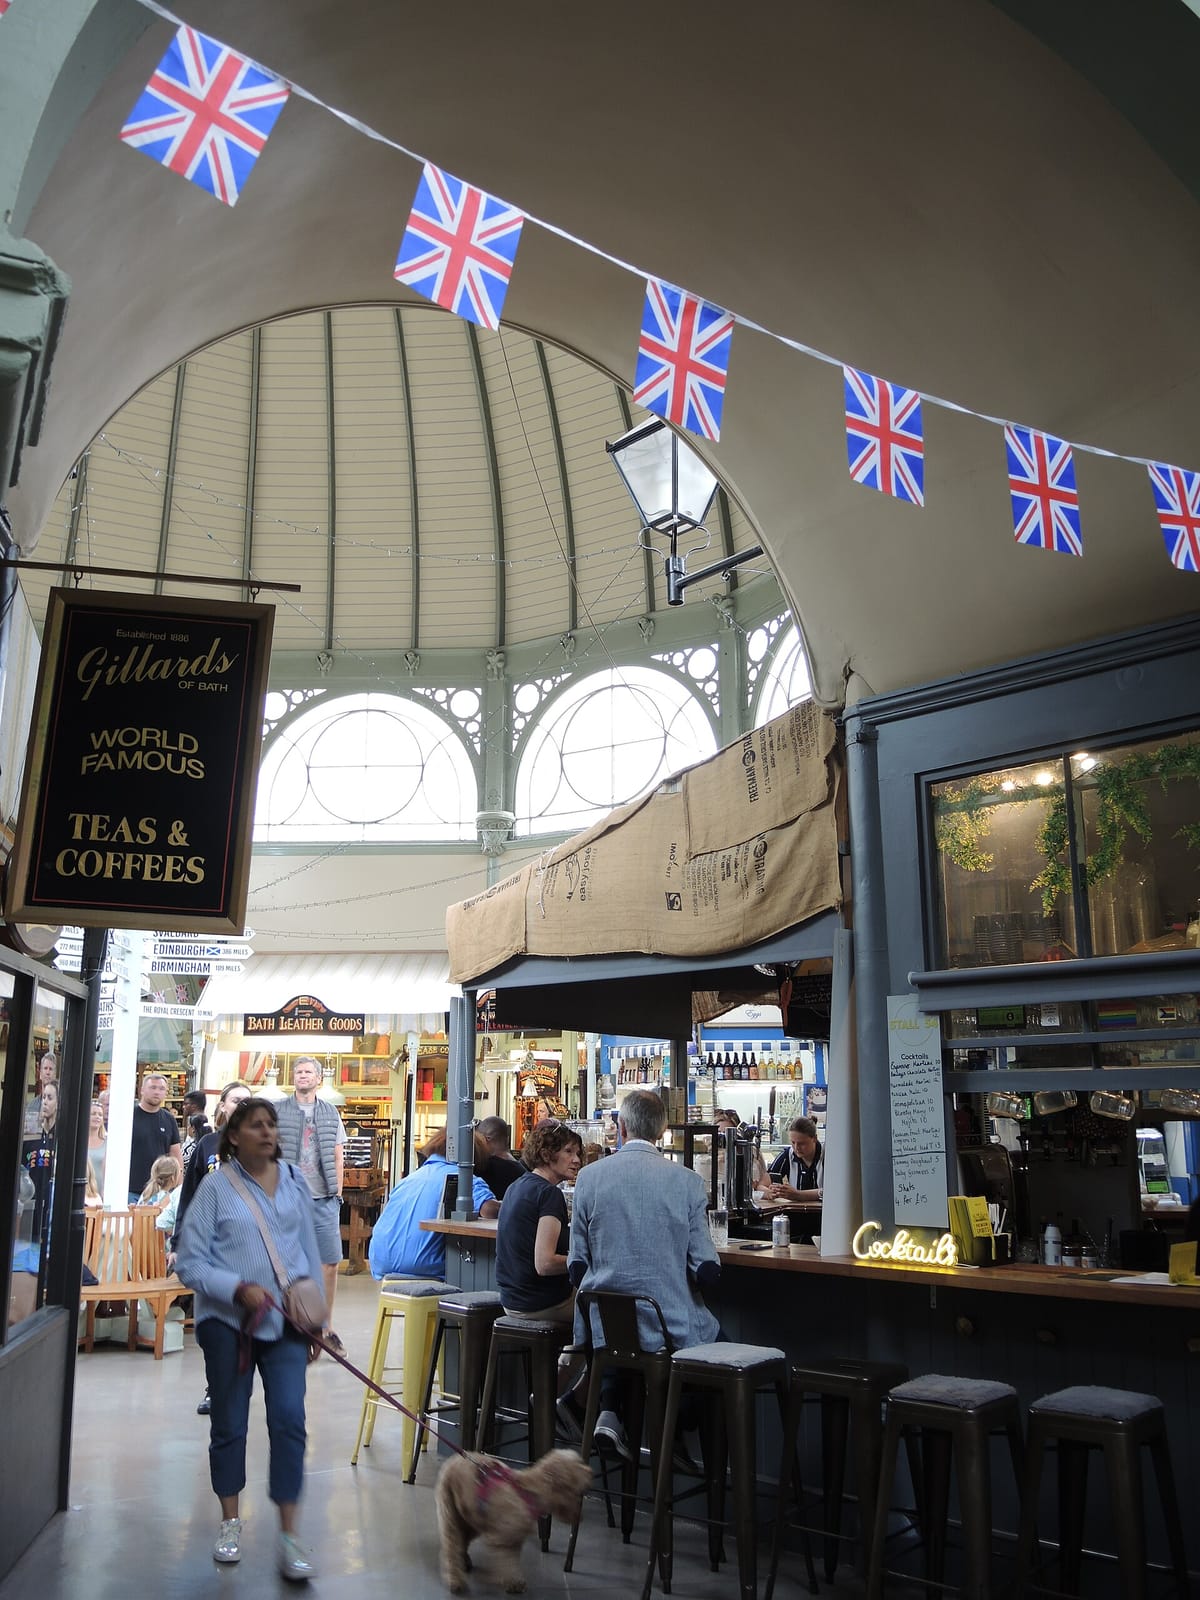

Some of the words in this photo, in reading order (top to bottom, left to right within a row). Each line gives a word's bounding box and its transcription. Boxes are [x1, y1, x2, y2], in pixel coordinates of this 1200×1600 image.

[116, 629, 166, 642] Established
[170, 633, 190, 642] 1886
[76, 638, 240, 701] Gillards
[178, 680, 195, 690] OF
[198, 682, 228, 692] BATH
[90, 727, 199, 754] WORLD
[81, 751, 206, 779] FAMOUS
[746, 766, 759, 802] FREEMAN
[68, 813, 157, 845] TEAS
[167, 820, 190, 847] &
[55, 849, 206, 884] COFFEES
[580, 874, 589, 902] easy
[153, 944, 206, 956] EDINBURGH
[151, 961, 211, 974] BIRMINGHAM
[143, 1006, 152, 1014] THE
[154, 1006, 169, 1015] ROYAL
[170, 1008, 195, 1016] CRESCENT
[745, 1009, 761, 1020] Eggs
[248, 1016, 275, 1031] BATH
[279, 1016, 324, 1031] LEATHER
[328, 1016, 362, 1031] GOODS
[898, 1182, 916, 1192] Shots
[853, 1221, 958, 1266] Cocktails
